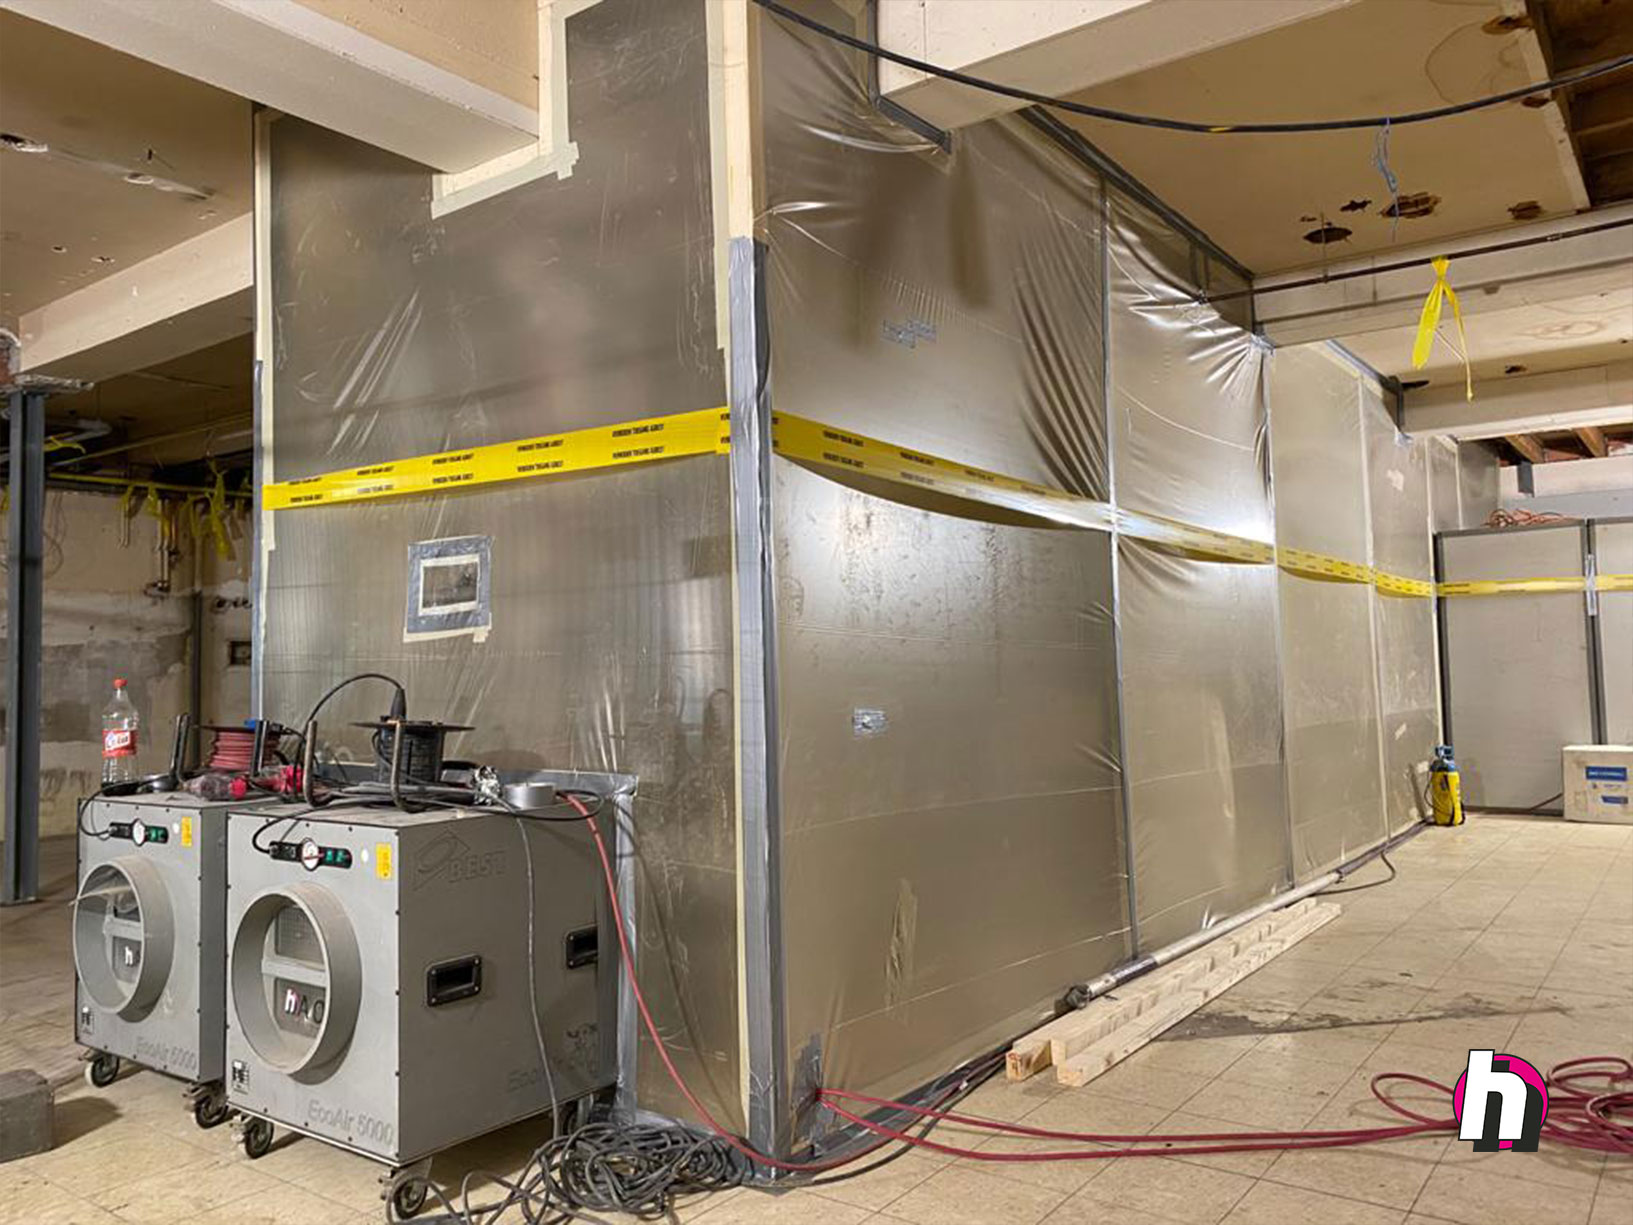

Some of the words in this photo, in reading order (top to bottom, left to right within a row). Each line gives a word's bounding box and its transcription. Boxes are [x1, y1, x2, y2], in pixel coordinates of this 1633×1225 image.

[447, 850, 507, 884] BEST
[308, 1099, 355, 1132] EcoAir
[357, 1112, 395, 1147] 5000
